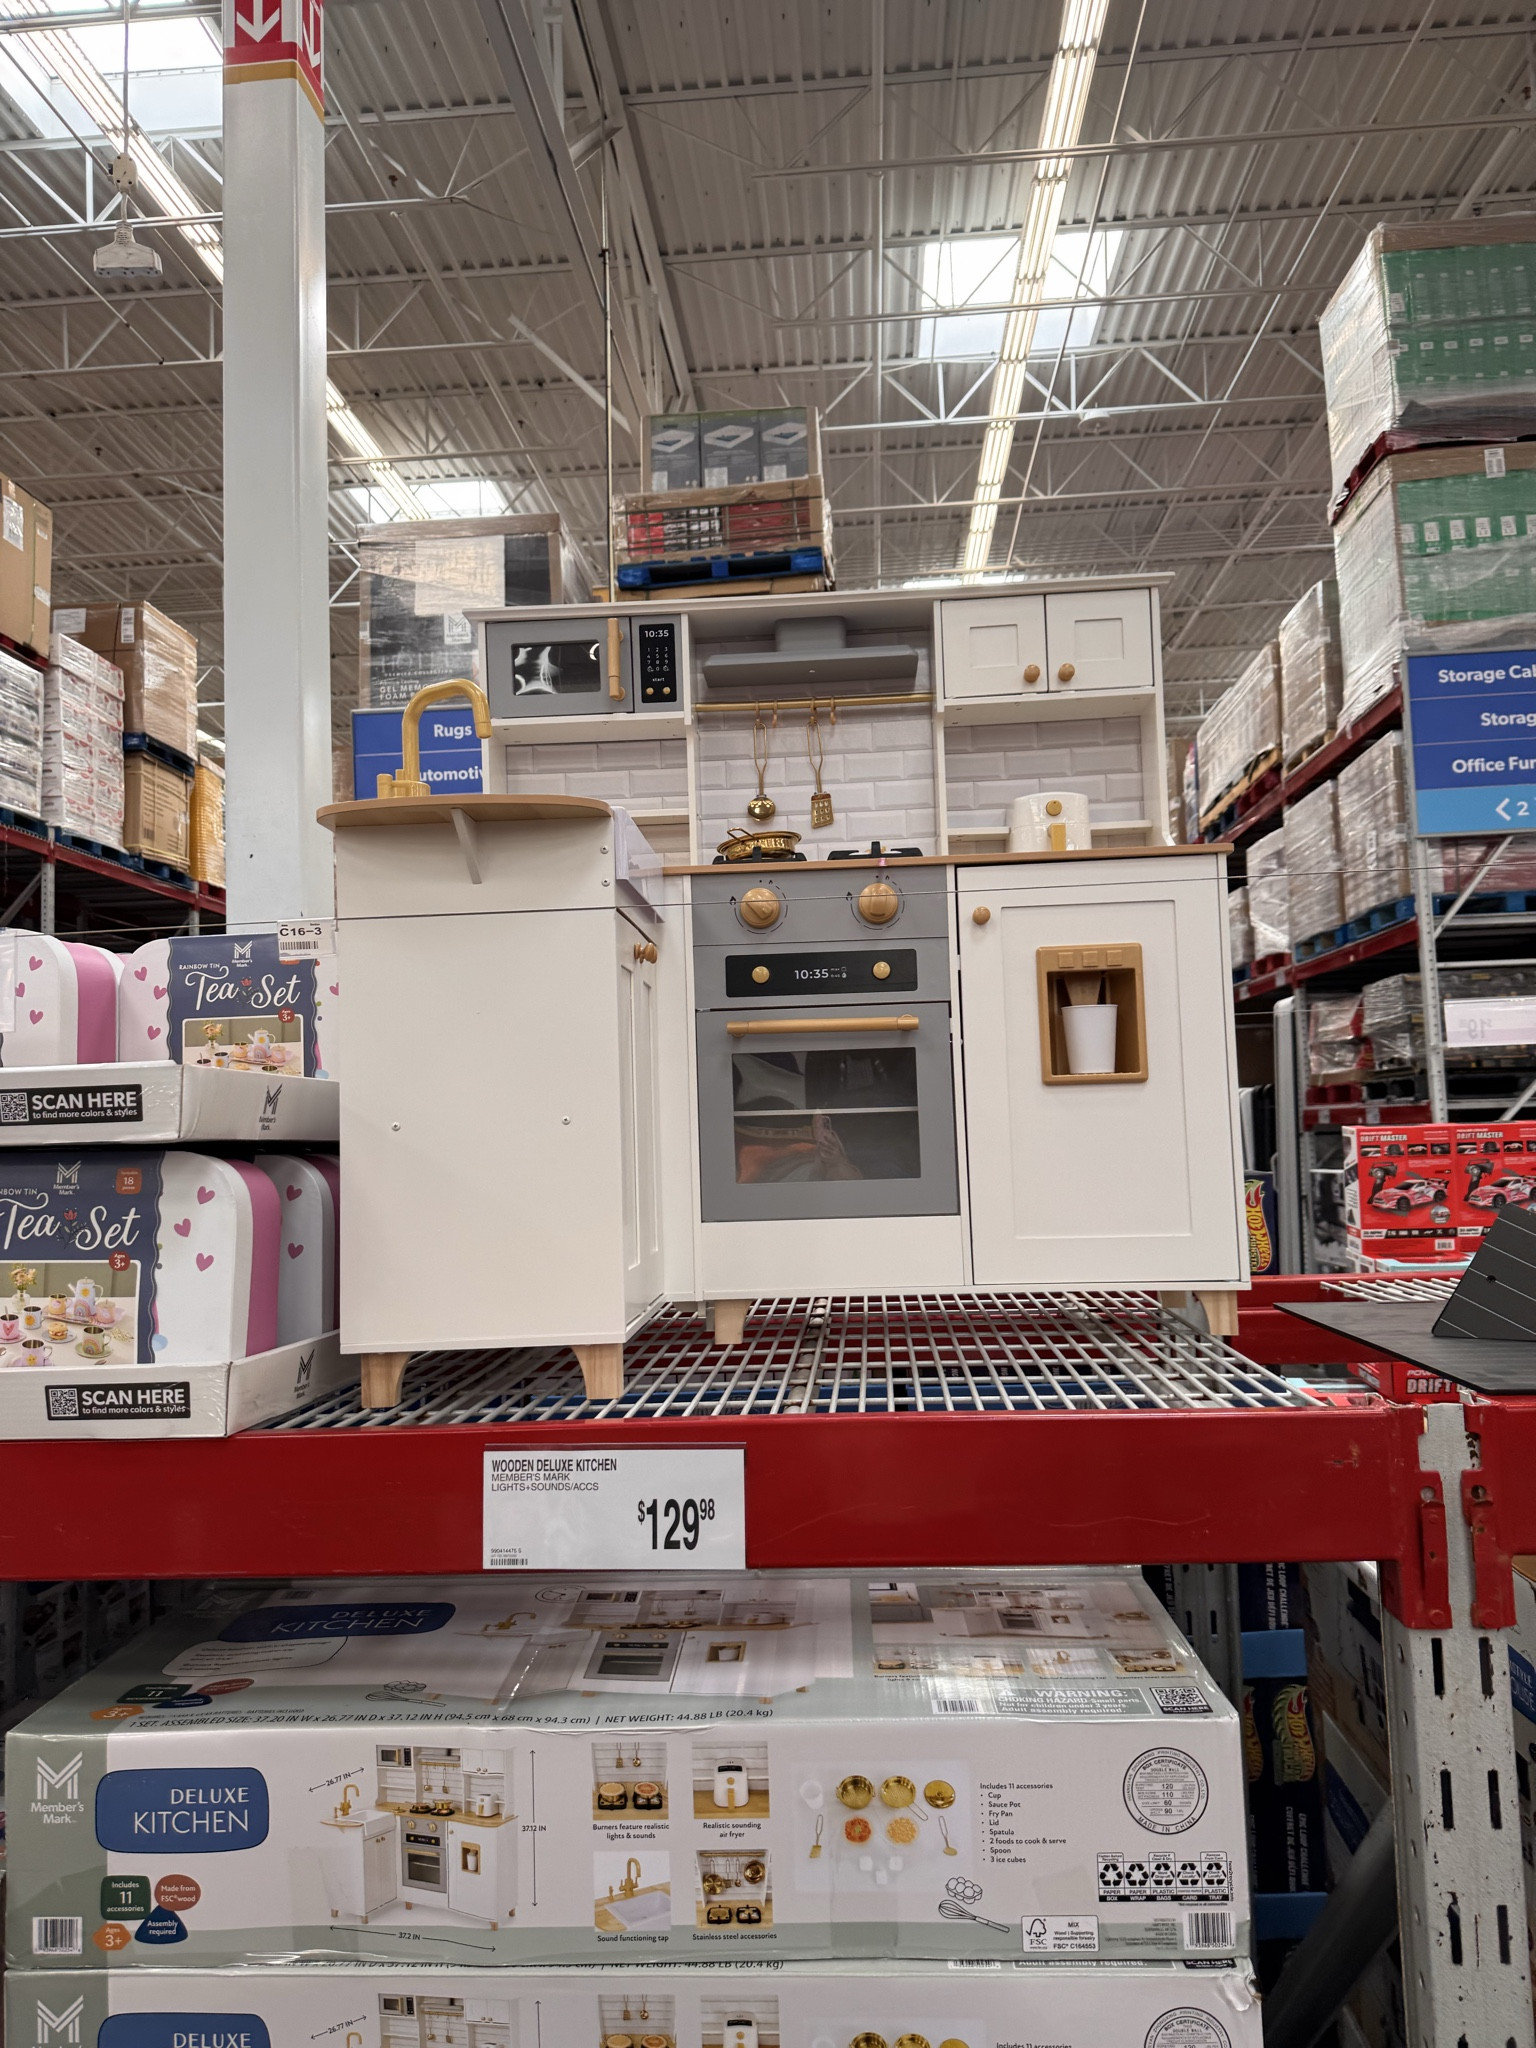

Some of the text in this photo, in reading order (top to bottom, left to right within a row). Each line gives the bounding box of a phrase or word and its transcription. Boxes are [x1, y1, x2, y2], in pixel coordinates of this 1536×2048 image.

[644, 629, 669, 638] 10:35
[1438, 668, 1506, 684] Storage
[1480, 712, 1536, 727] Storag
[433, 724, 473, 740] Rugs
[1452, 758, 1505, 773] Office
[1516, 801, 1530, 816] 2
[279, 927, 322, 937] C16-3
[794, 968, 829, 980] 10:35
[185, 966, 302, 1011] Tea Set
[31, 1091, 137, 1111] SCAN HERE
[42, 1110, 58, 1119] find
[80, 1109, 105, 1117] colors
[106, 1108, 114, 1117] &
[114, 1107, 138, 1117] styles
[1380, 1133, 1408, 1142] MASTER
[1476, 1131, 1503, 1139] MASTER
[123, 1177, 134, 1185] 18
[0, 1192, 141, 1250] Tea Set
[114, 1259, 126, 1269] 3+
[1407, 1378, 1452, 1394] DRIFT
[81, 1388, 186, 1406] SCAN HERE
[91, 1406, 107, 1414] find
[163, 1405, 186, 1414] styles
[492, 1458, 617, 1473] WOODEN DELUXE KITCHEN
[491, 1472, 570, 1481] MEMBER'S MARK
[491, 1482, 599, 1492] LIGHTS+SOUNDS/ACCS
[331, 1609, 434, 1620] DELUXE
[270, 1617, 424, 1634] KITCHEN
[1034, 1689, 1128, 1698] WARNING:
[137, 1720, 158, 1728] SET.
[160, 1716, 226, 1727] ASSEMBLED
[226, 1715, 252, 1724] SIZE:
[253, 1715, 286, 1723] 37.20
[286, 1714, 299, 1722] IN
[321, 1714, 354, 1722] 26.77
[388, 1713, 419, 1721] 37.12
[419, 1713, 434, 1721] IN
[445, 1712, 473, 1722] (94.5
[543, 1716, 569, 1724] 94.3
[569, 1716, 591, 1725] cm)
[604, 1715, 628, 1723] NET
[628, 1713, 674, 1723] WEIGHT:
[676, 1712, 708, 1721] 44.88
[709, 1710, 723, 1718] LB
[725, 1709, 753, 1718] (20.4
[754, 1709, 774, 1718] kg)
[979, 1782, 1007, 1790] Includes
[170, 1787, 250, 1805] DELUXE
[987, 1792, 1001, 1800] Cup
[30, 1802, 84, 1813] Member's
[43, 1813, 73, 1824] Mark
[988, 1810, 999, 1818] Fry
[133, 1809, 249, 1835] KITCHEN
[592, 1823, 618, 1831] Burners
[644, 1822, 669, 1830] realistic
[731, 1821, 762, 1830] sounding
[1175, 1816, 1196, 1832] CHINA
[606, 1832, 625, 1841] lights
[728, 1831, 745, 1839] fryer
[989, 1828, 1015, 1836] Spatula
[180, 1884, 196, 1892] from
[119, 1890, 132, 1904] 11
[147, 1920, 178, 1928] Assembly
[149, 1928, 177, 1937] required
[692, 1933, 724, 1941] Stainless
[105, 1934, 122, 1947] 3+
[619, 1934, 657, 1943] functioning
[657, 1935, 669, 1943] tap
[173, 2032, 252, 2048] DELUXE
